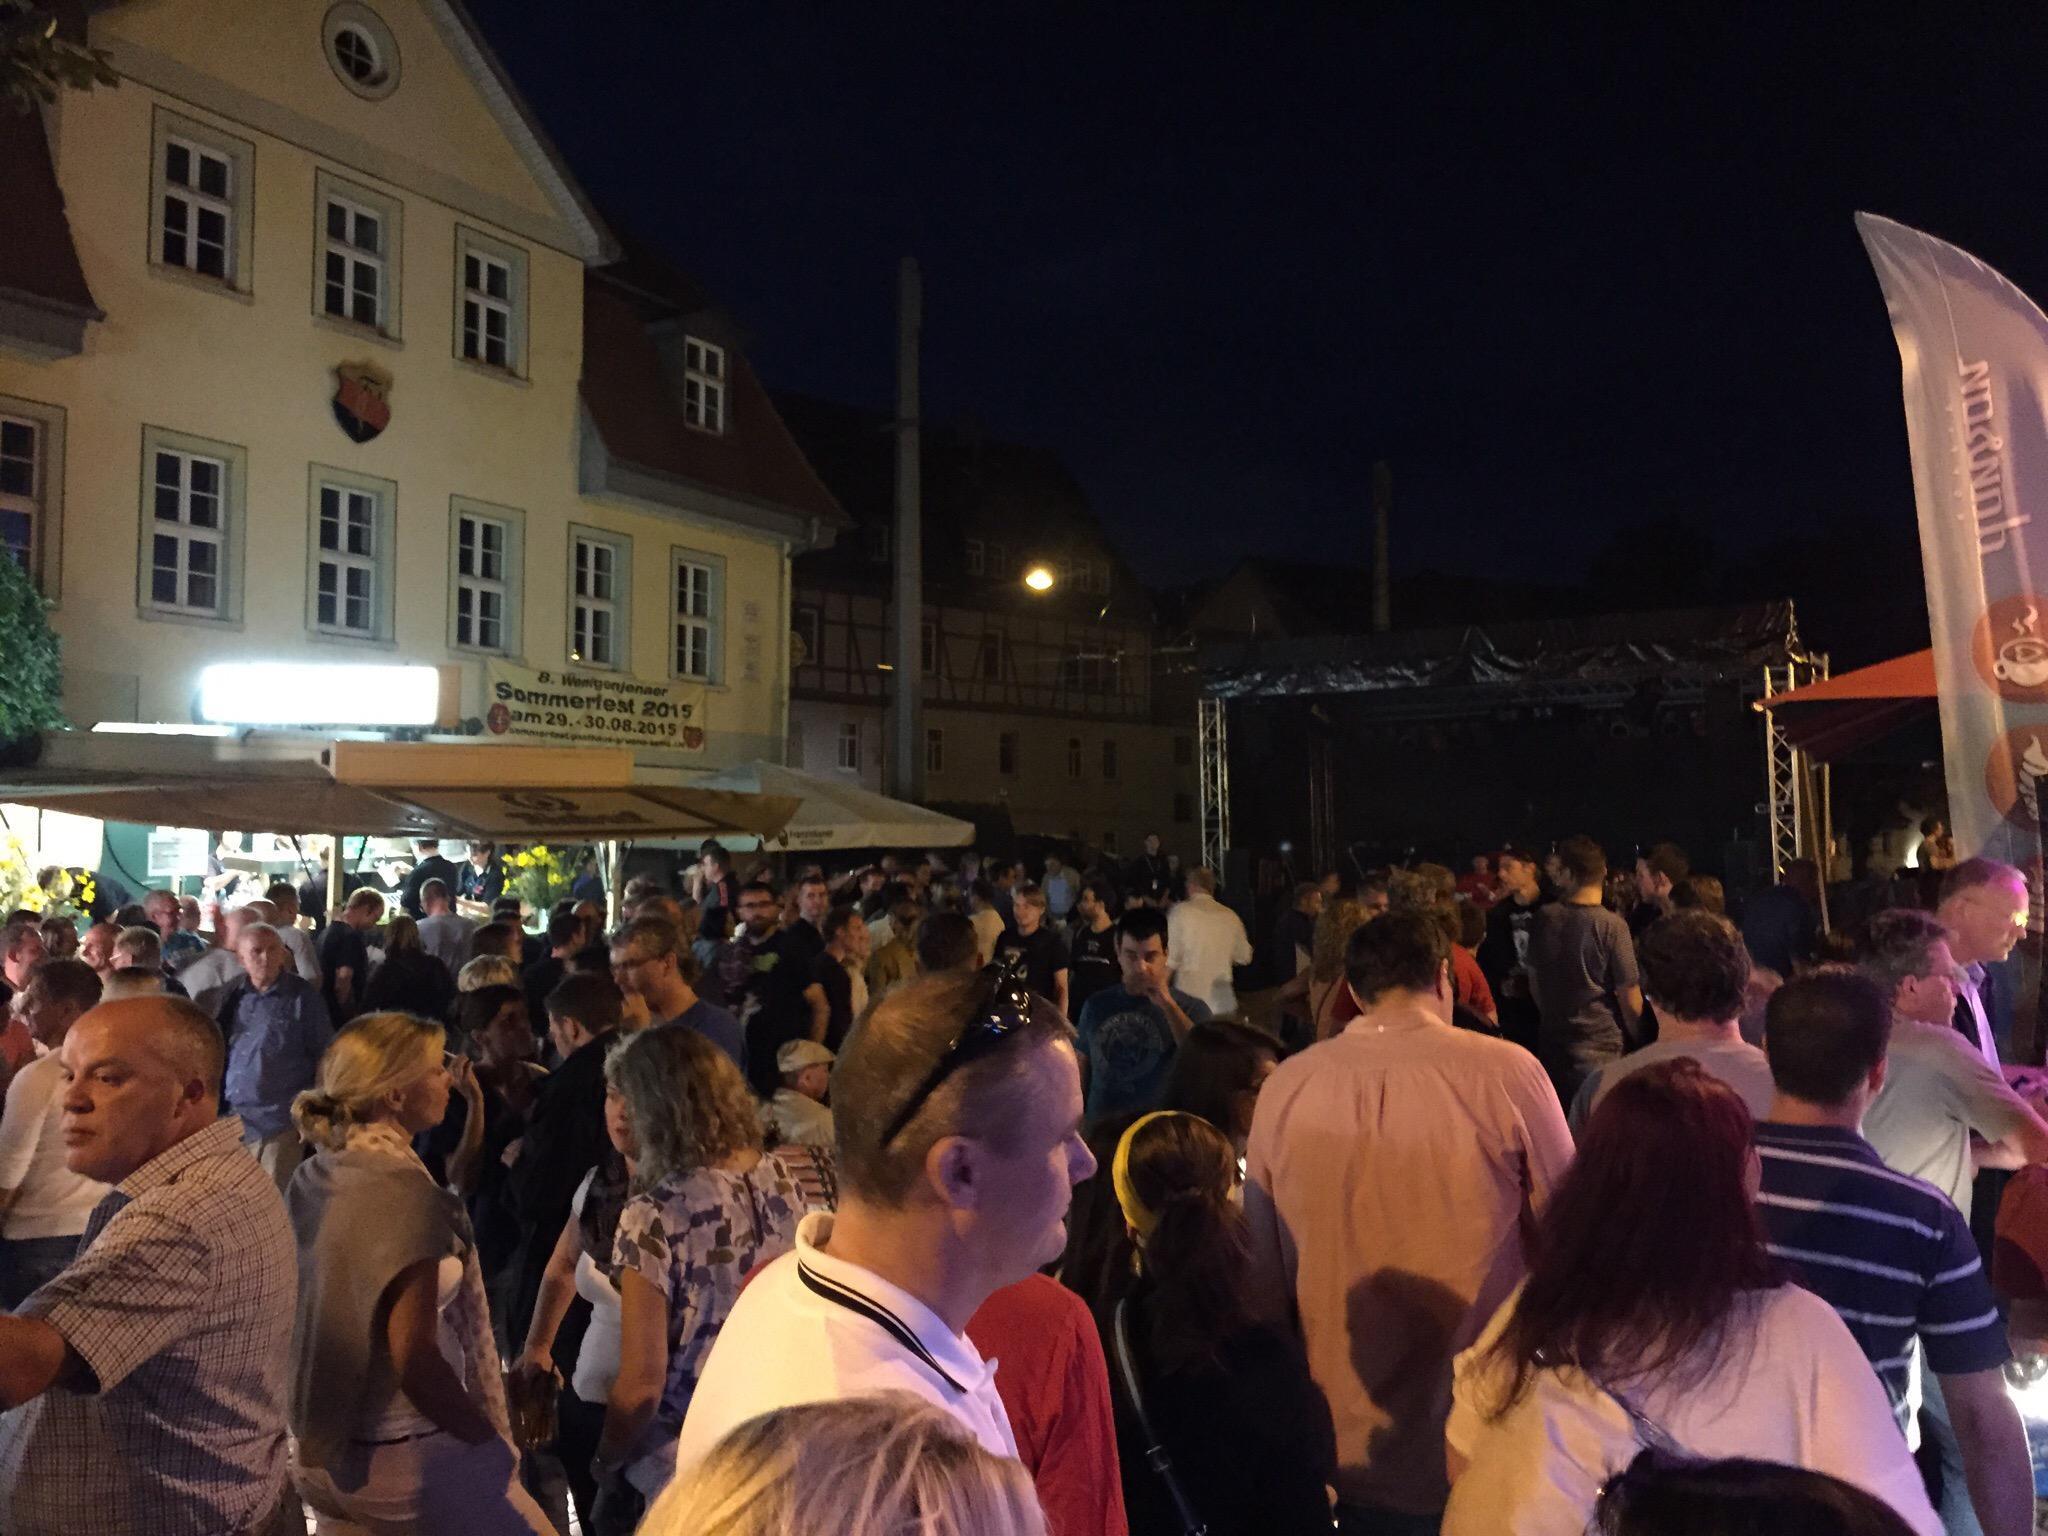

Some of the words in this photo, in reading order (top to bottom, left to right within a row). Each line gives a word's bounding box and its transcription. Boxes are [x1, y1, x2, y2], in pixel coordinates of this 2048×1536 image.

[538, 671, 555, 685] 8.
[495, 681, 635, 715] Sommerfest
[642, 700, 693, 720] 2015
[511, 708, 541, 726] am
